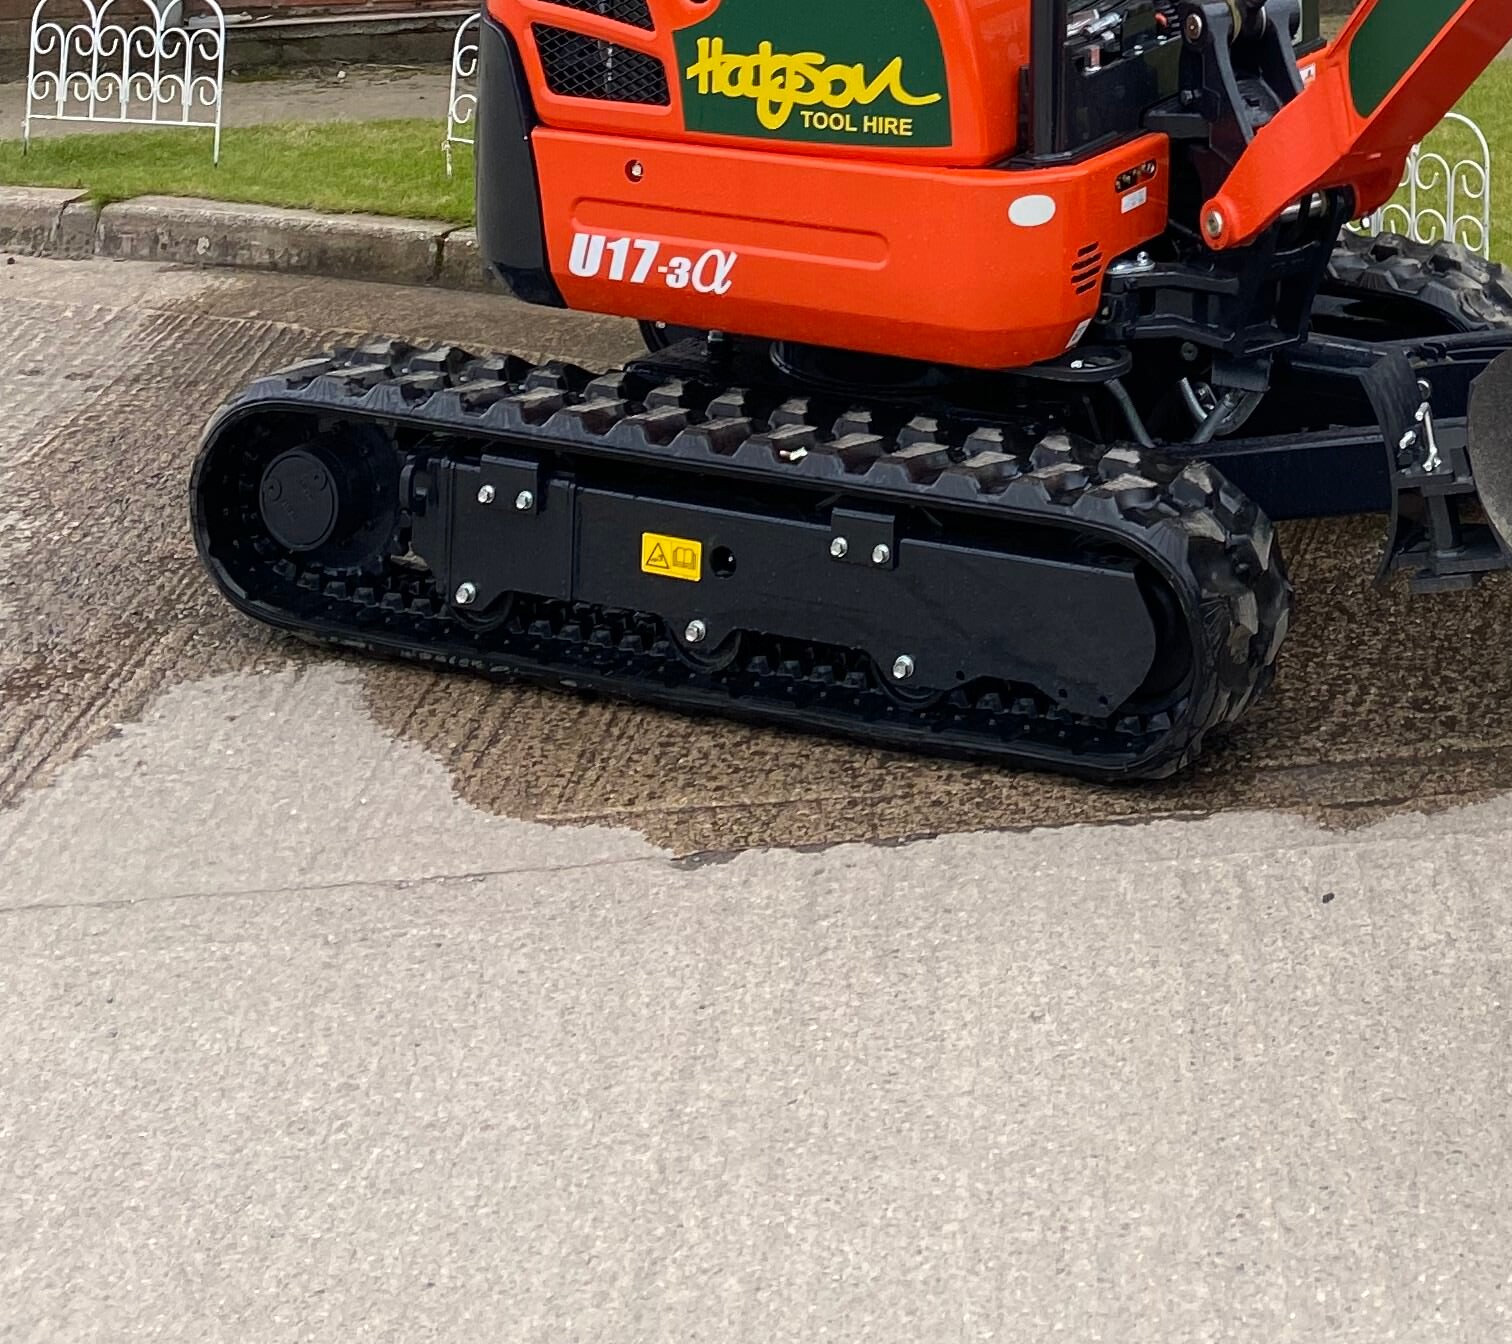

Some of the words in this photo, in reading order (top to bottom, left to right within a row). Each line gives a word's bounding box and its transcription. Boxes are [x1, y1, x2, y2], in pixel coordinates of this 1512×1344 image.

[686, 36, 942, 130] Hodgson
[800, 111, 858, 132] TOOL
[863, 116, 913, 136] HIRE
